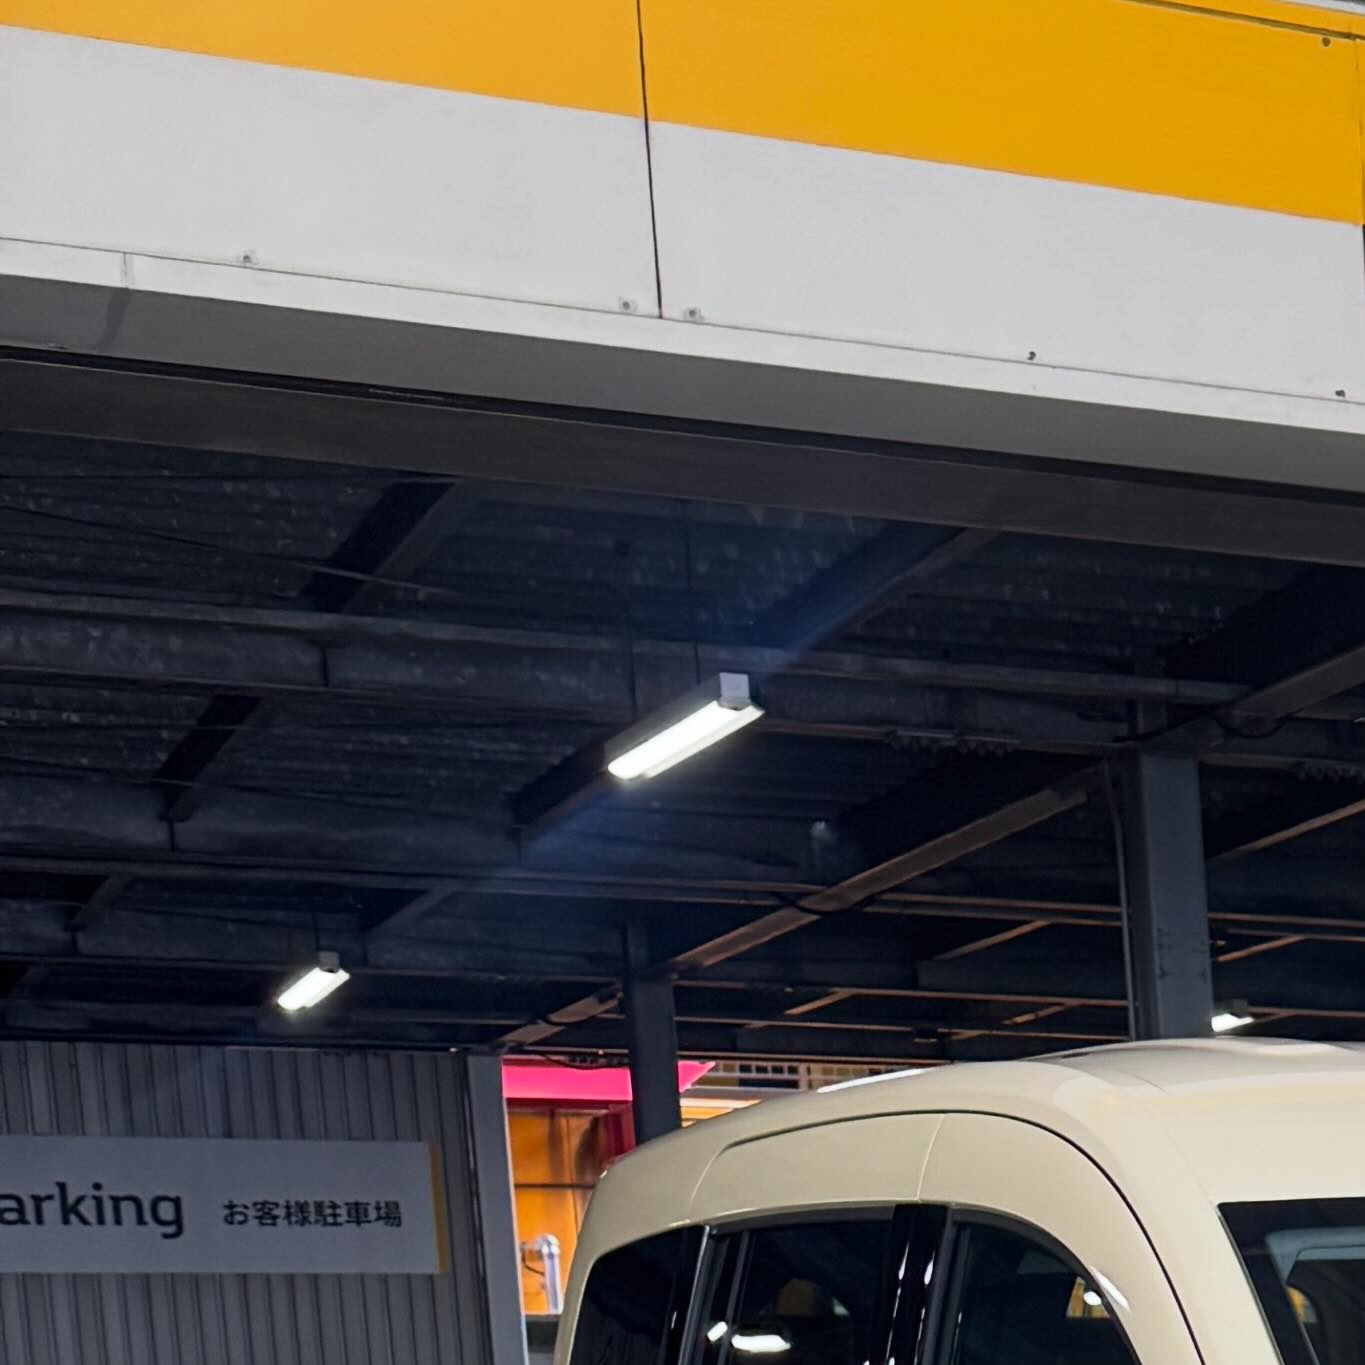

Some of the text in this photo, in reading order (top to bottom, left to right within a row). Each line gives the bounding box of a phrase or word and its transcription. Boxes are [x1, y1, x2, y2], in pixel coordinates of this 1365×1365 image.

[0, 1181, 184, 1239] arking
[223, 1200, 402, 1227] お客様駐車場
